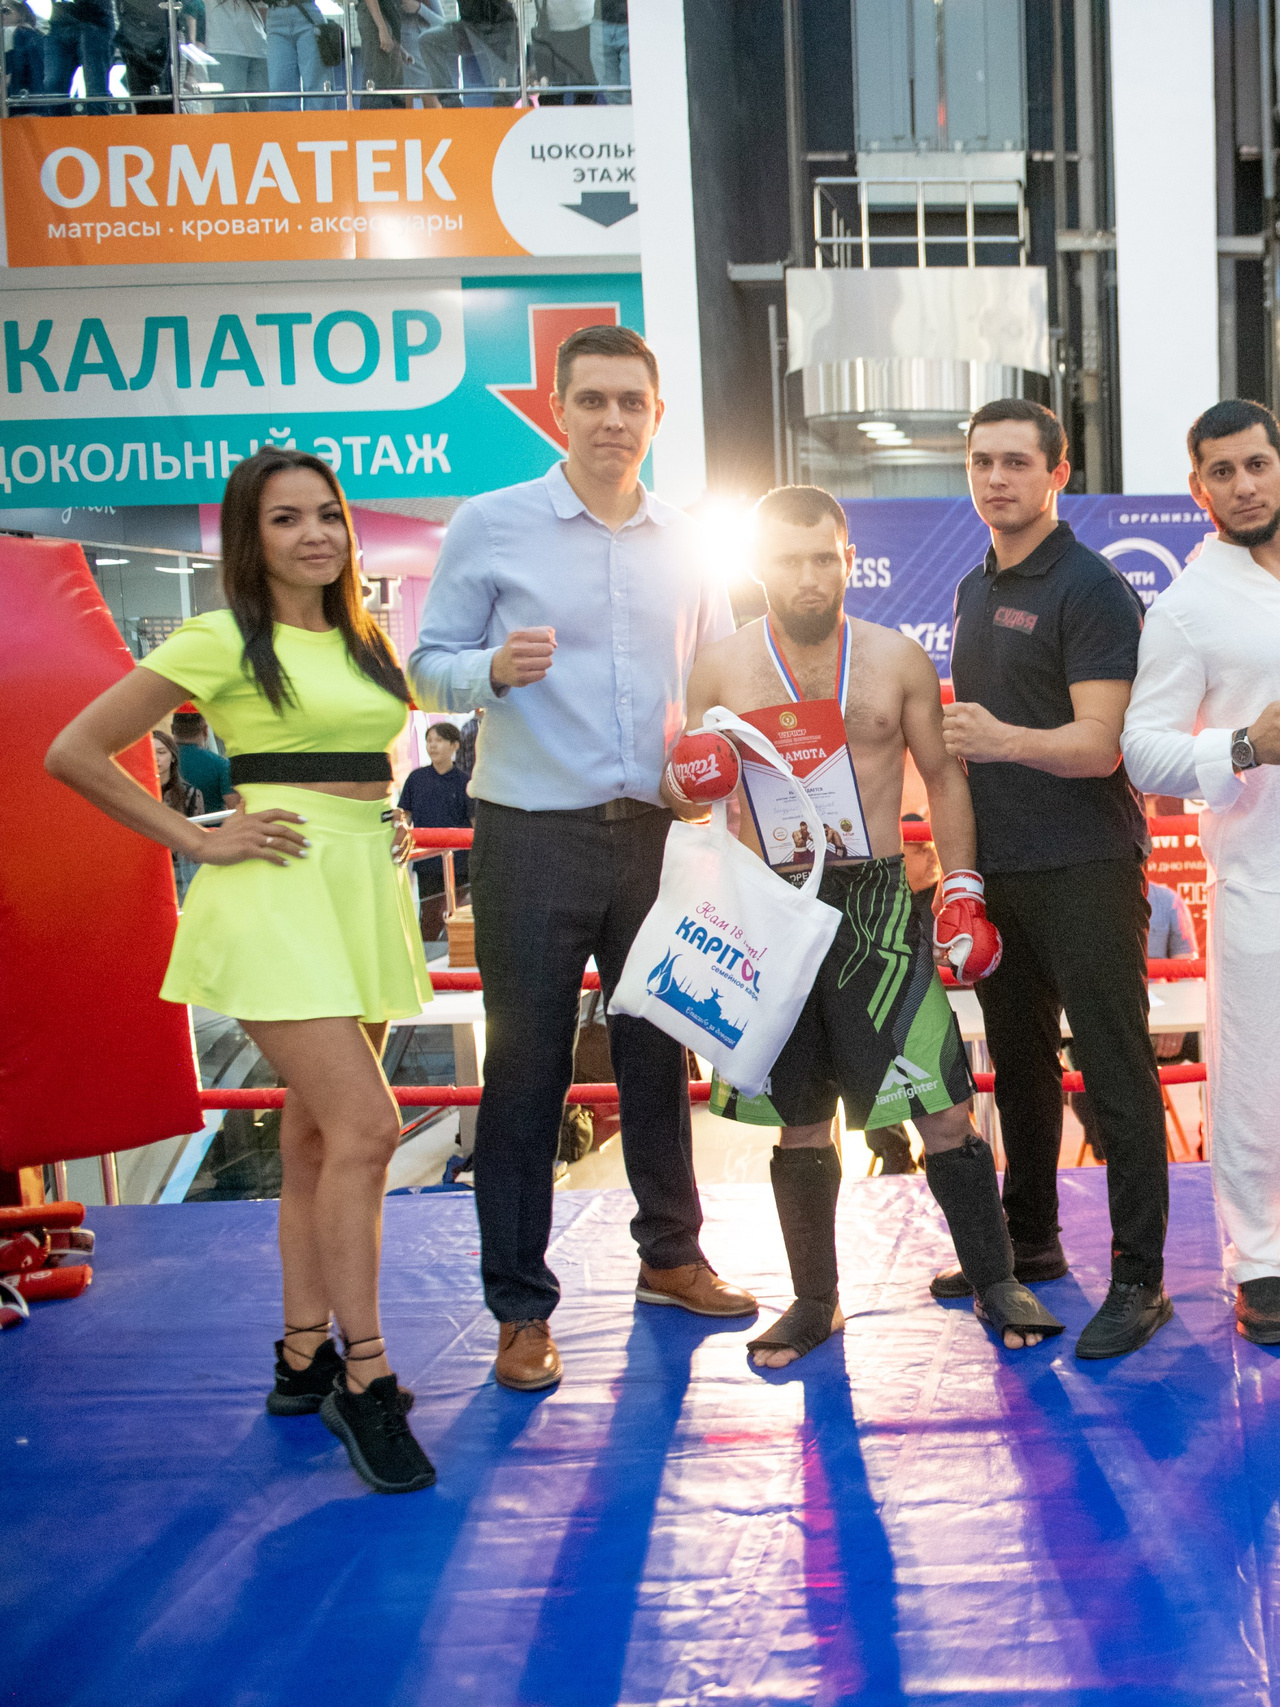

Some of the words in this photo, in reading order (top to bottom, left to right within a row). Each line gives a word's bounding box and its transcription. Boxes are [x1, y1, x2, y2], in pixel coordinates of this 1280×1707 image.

[40, 138, 457, 208] ORMATEK
[573, 167, 636, 183] ЭТАЖ
[48, 221, 161, 244] матрасы
[182, 217, 289, 242] кровати
[310, 213, 463, 238] аксесуары
[3, 309, 442, 394] КАЛАТОР
[313, 432, 451, 476] ЭТАЖ
[847, 557, 891, 588] ESS
[696, 901, 729, 930] Нам
[730, 925, 743, 940] 18
[675, 915, 761, 994] KAPITOL
[711, 964, 745, 989] семейное
[875, 1080, 939, 1106] iamfighter
